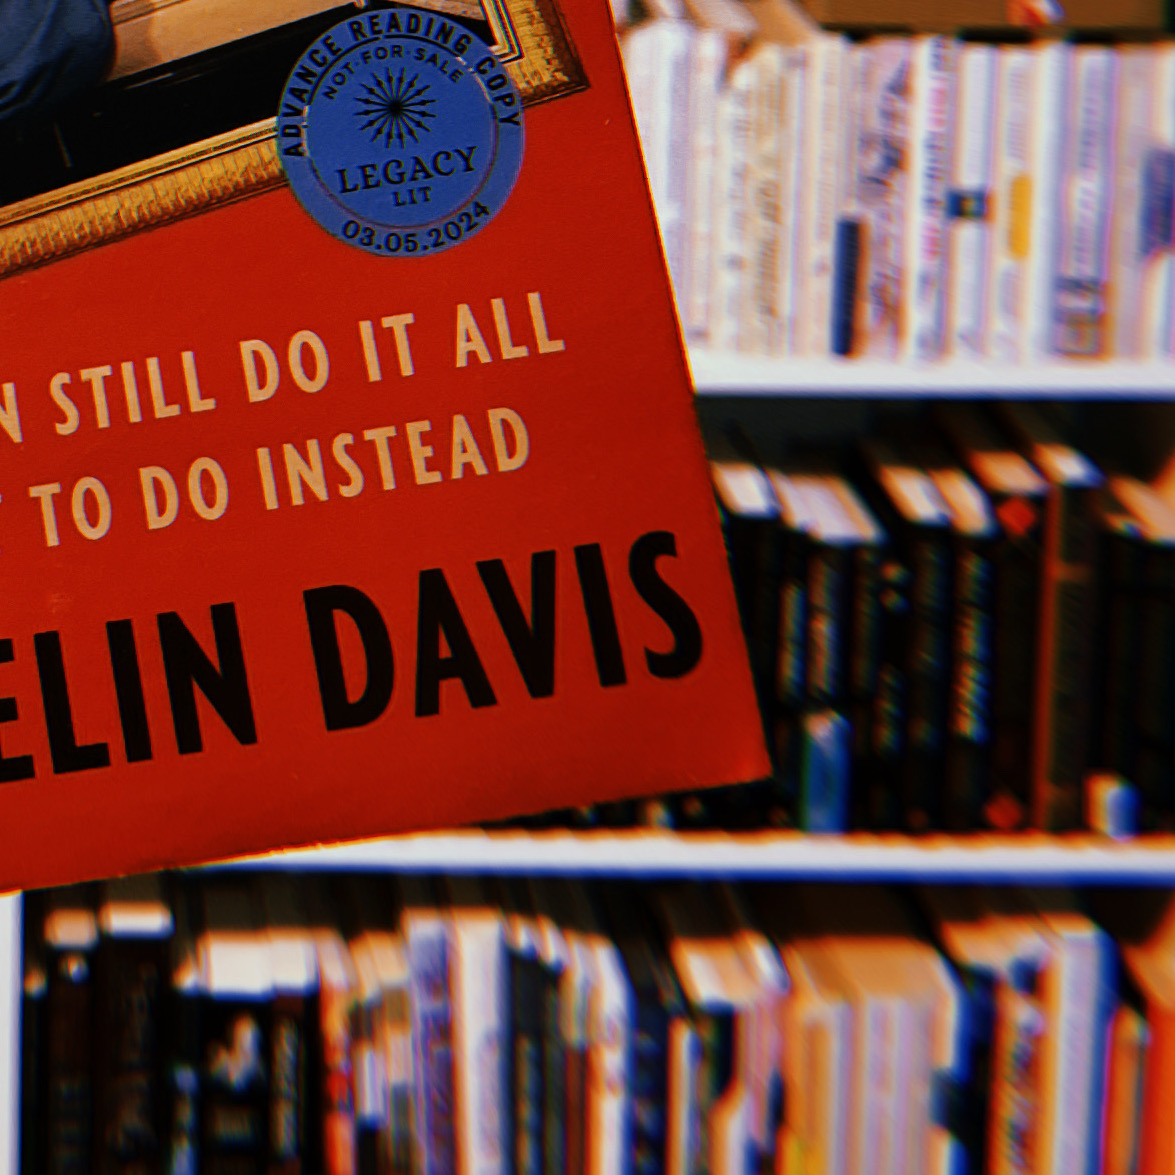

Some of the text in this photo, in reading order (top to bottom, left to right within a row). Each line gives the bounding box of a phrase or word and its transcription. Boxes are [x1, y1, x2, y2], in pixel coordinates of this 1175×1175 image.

[283, 13, 522, 157] ADVANCE READING COPY
[336, 146, 478, 194] LEGACY
[343, 201, 490, 252] 03.05.2024
[393, 186, 432, 207] LIT
[50, 351, 215, 435] STILL
[240, 330, 329, 402] DO
[359, 313, 414, 382] IT
[456, 292, 565, 367] ALL
[29, 477, 111, 547] TO
[139, 457, 228, 529] DO
[257, 408, 528, 510] INSTEAD
[303, 531, 702, 731] DAVIS
